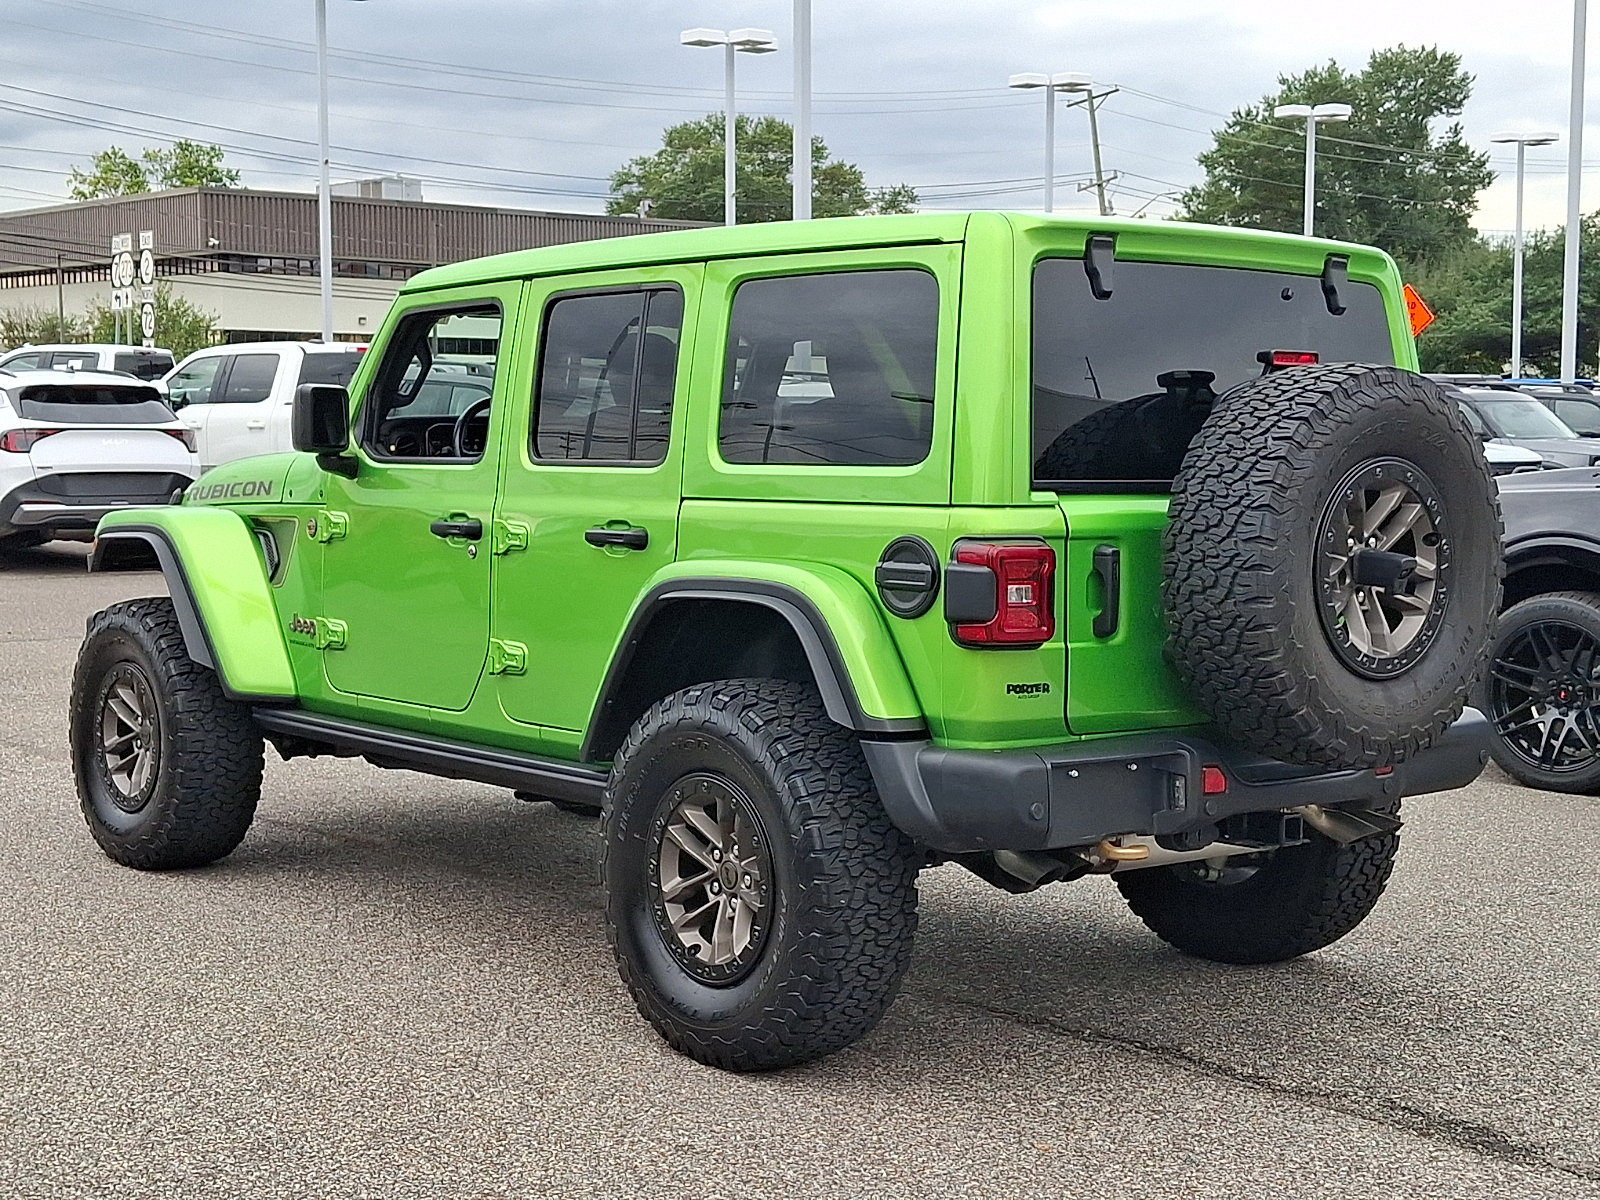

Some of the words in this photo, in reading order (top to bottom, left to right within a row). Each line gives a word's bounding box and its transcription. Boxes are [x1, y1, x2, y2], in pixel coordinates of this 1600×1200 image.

[145, 257, 150, 276] 2
[143, 311, 153, 330] 72
[187, 479, 274, 501] RUBICON
[288, 613, 317, 639] Jeep
[1006, 682, 1051, 694] PORTER
